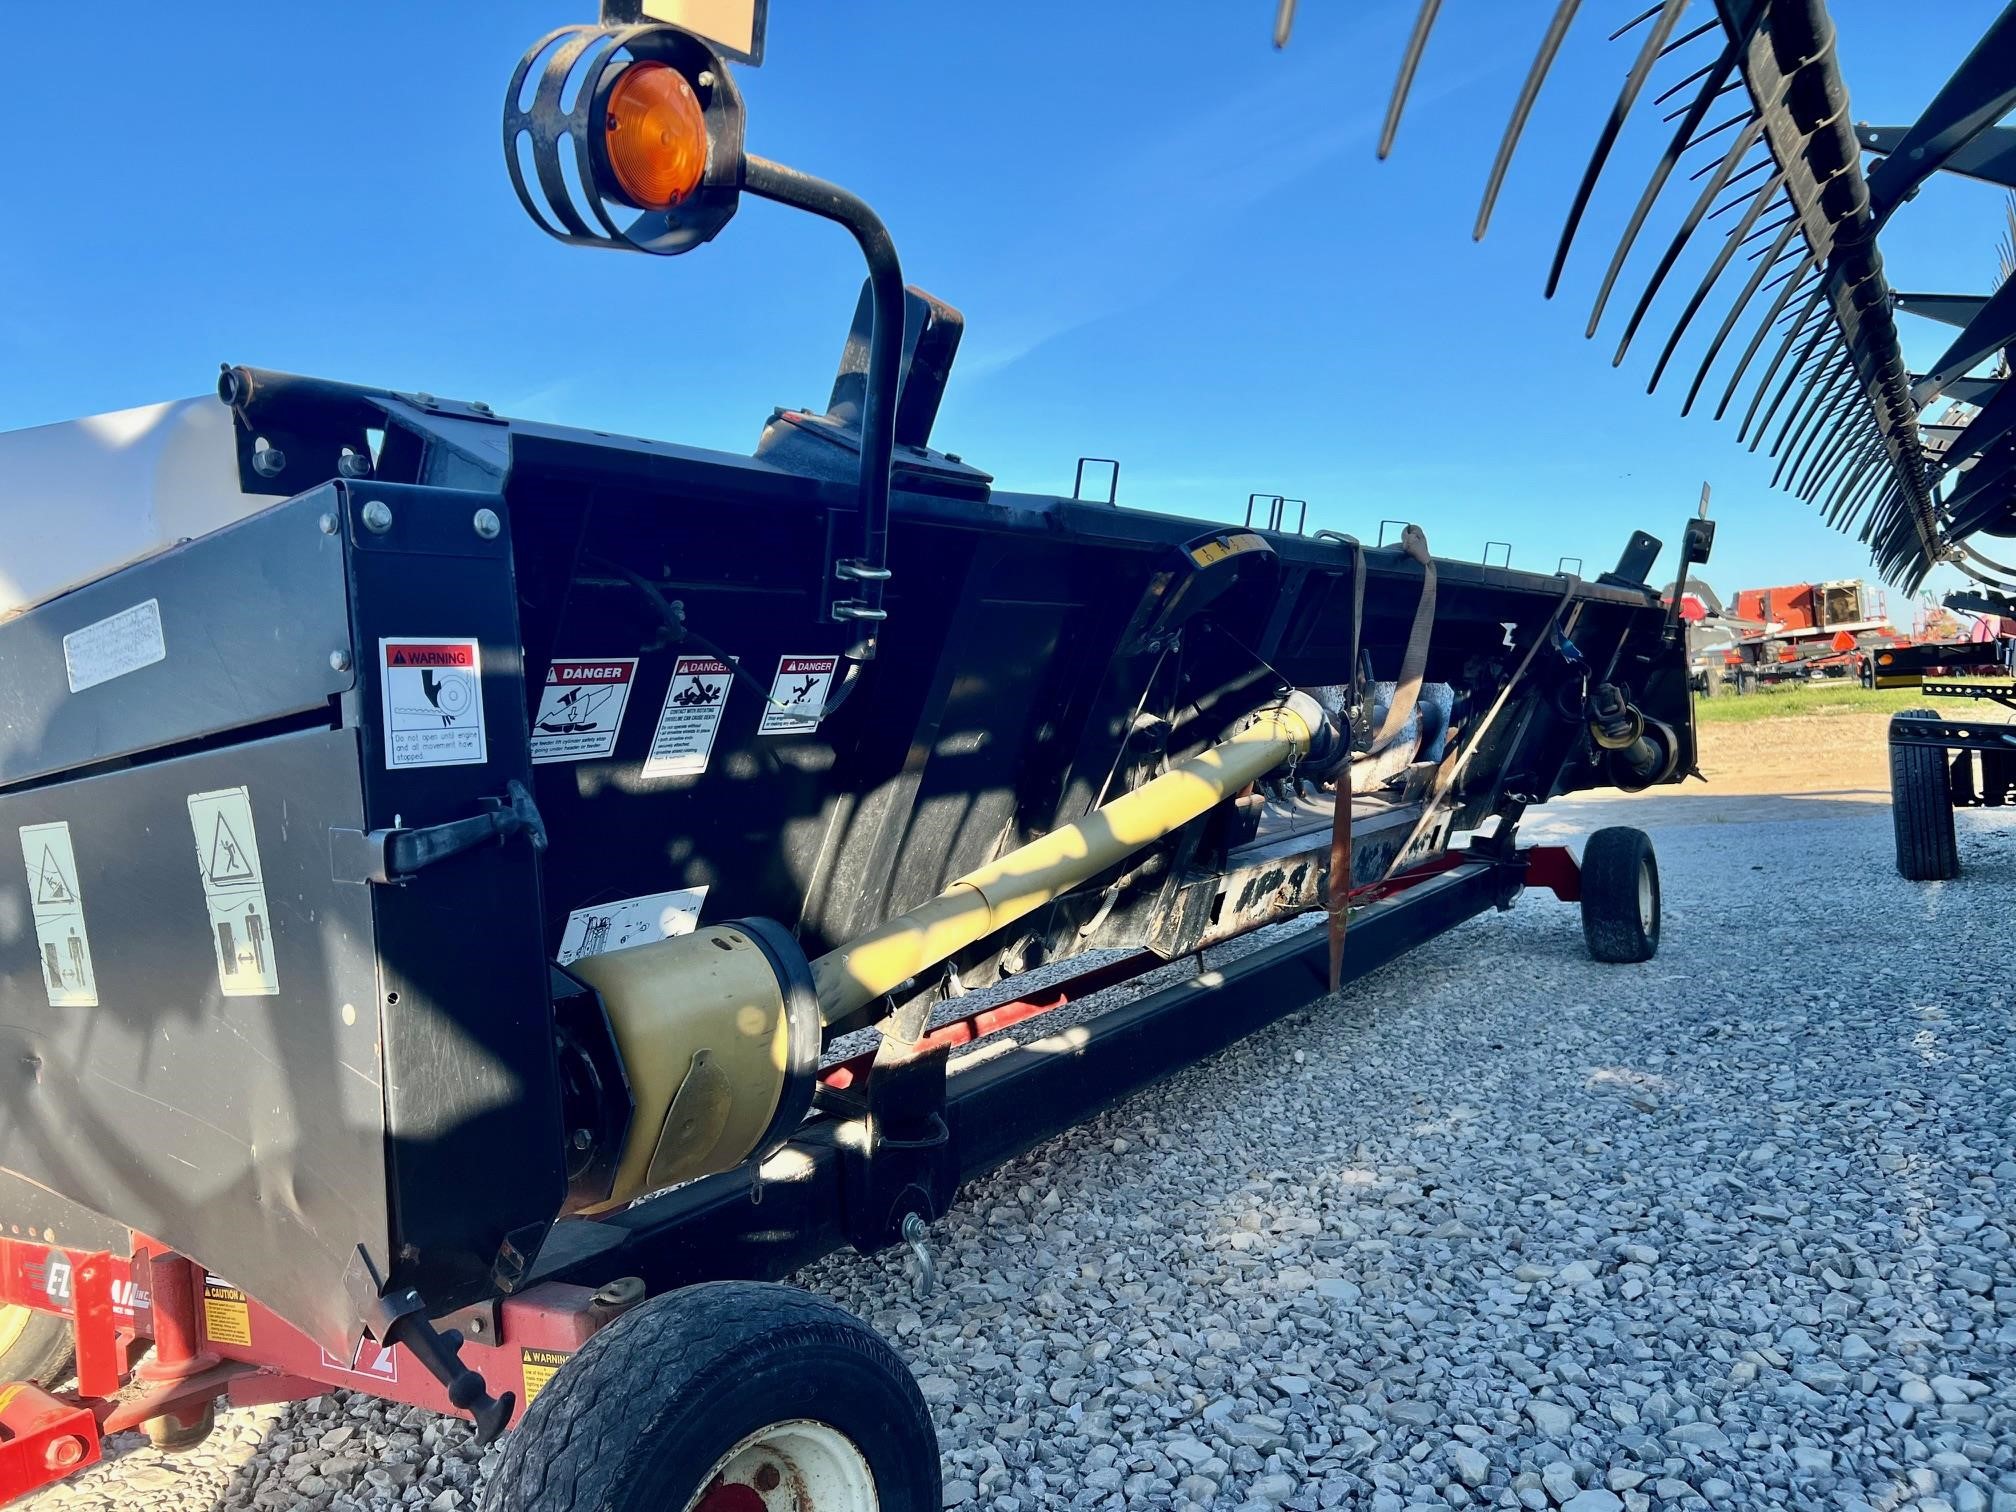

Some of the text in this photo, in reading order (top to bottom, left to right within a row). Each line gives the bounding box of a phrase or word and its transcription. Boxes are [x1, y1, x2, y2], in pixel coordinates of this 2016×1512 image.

[408, 653, 465, 665] WARNING
[797, 662, 832, 671] DANGER
[562, 667, 622, 679] DANGER
[396, 731, 478, 742] Do not open until engine
[396, 744, 408, 752] and
[423, 742, 455, 750] movement
[211, 1287, 239, 1300] CAUTION
